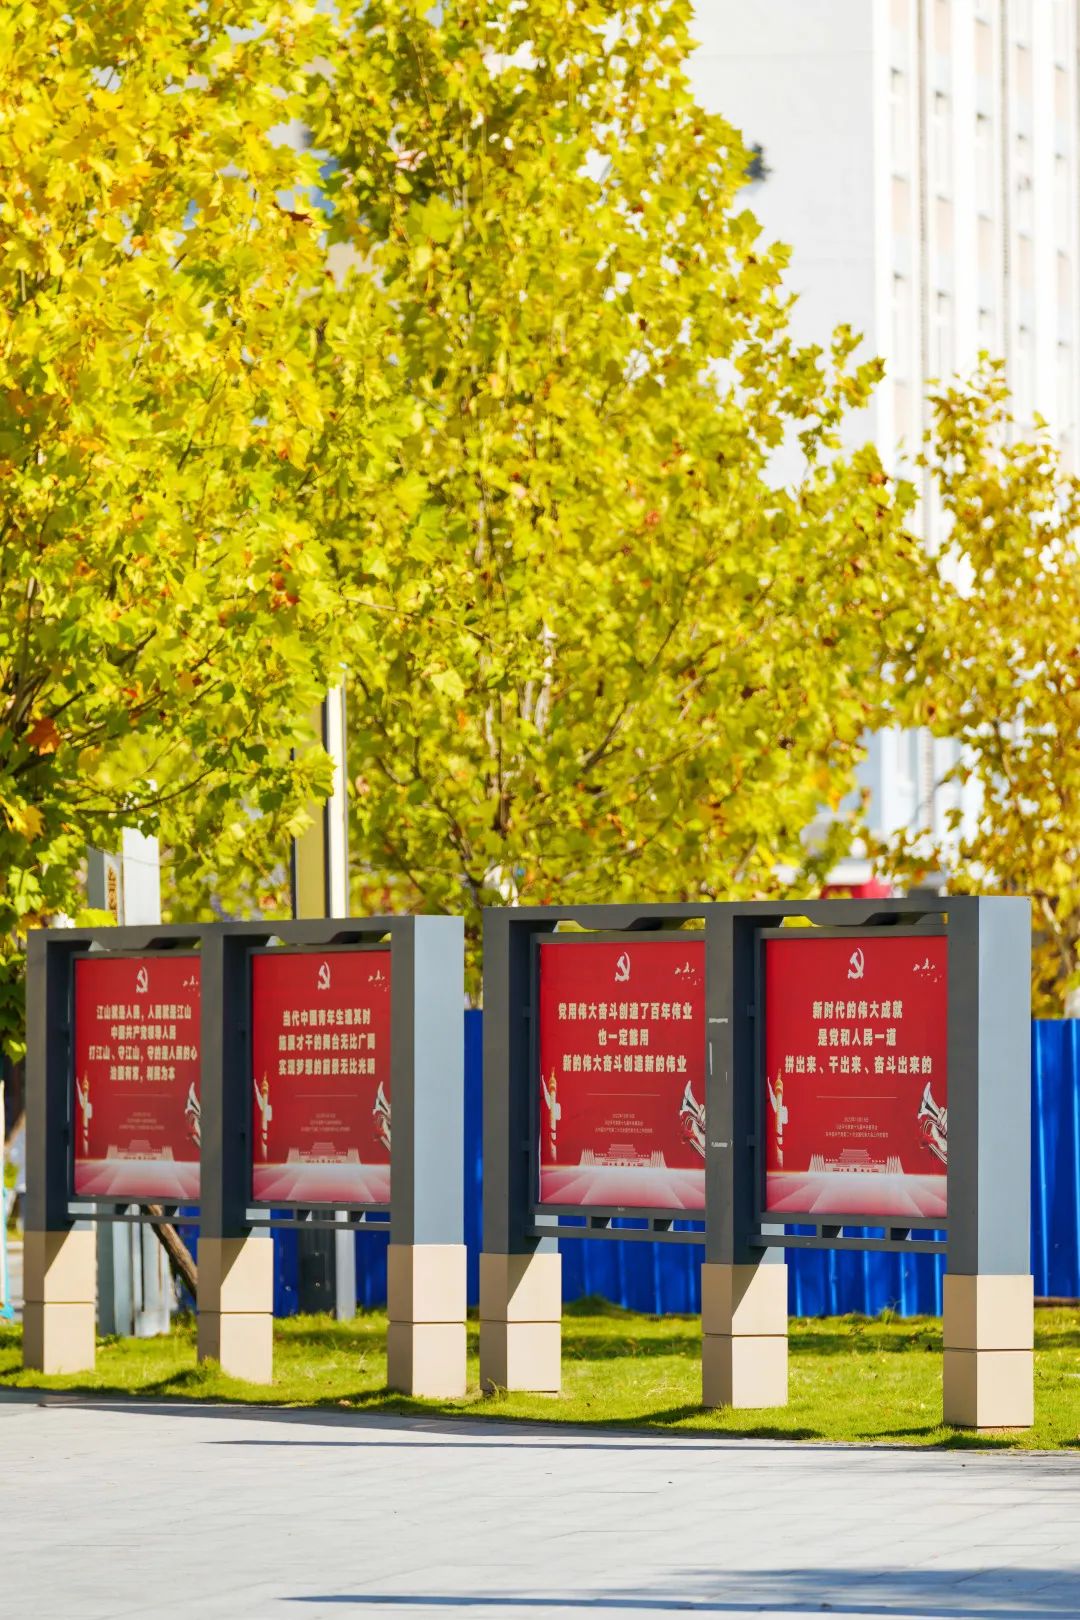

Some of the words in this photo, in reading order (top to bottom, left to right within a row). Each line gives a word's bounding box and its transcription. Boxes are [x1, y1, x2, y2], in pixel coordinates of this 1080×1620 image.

[558, 1002, 692, 1020] 党用伟大奋斗创造了百年伟业
[812, 1000, 903, 1019] 新时代的伟大成就
[598, 1028, 649, 1046] 也一定能用
[817, 1028, 896, 1047] 是党和人民一道
[562, 1054, 687, 1072] 新的伟大奋斗创造新的伟业
[785, 1055, 932, 1074] 拼出来、干出来、奋斗出来的
